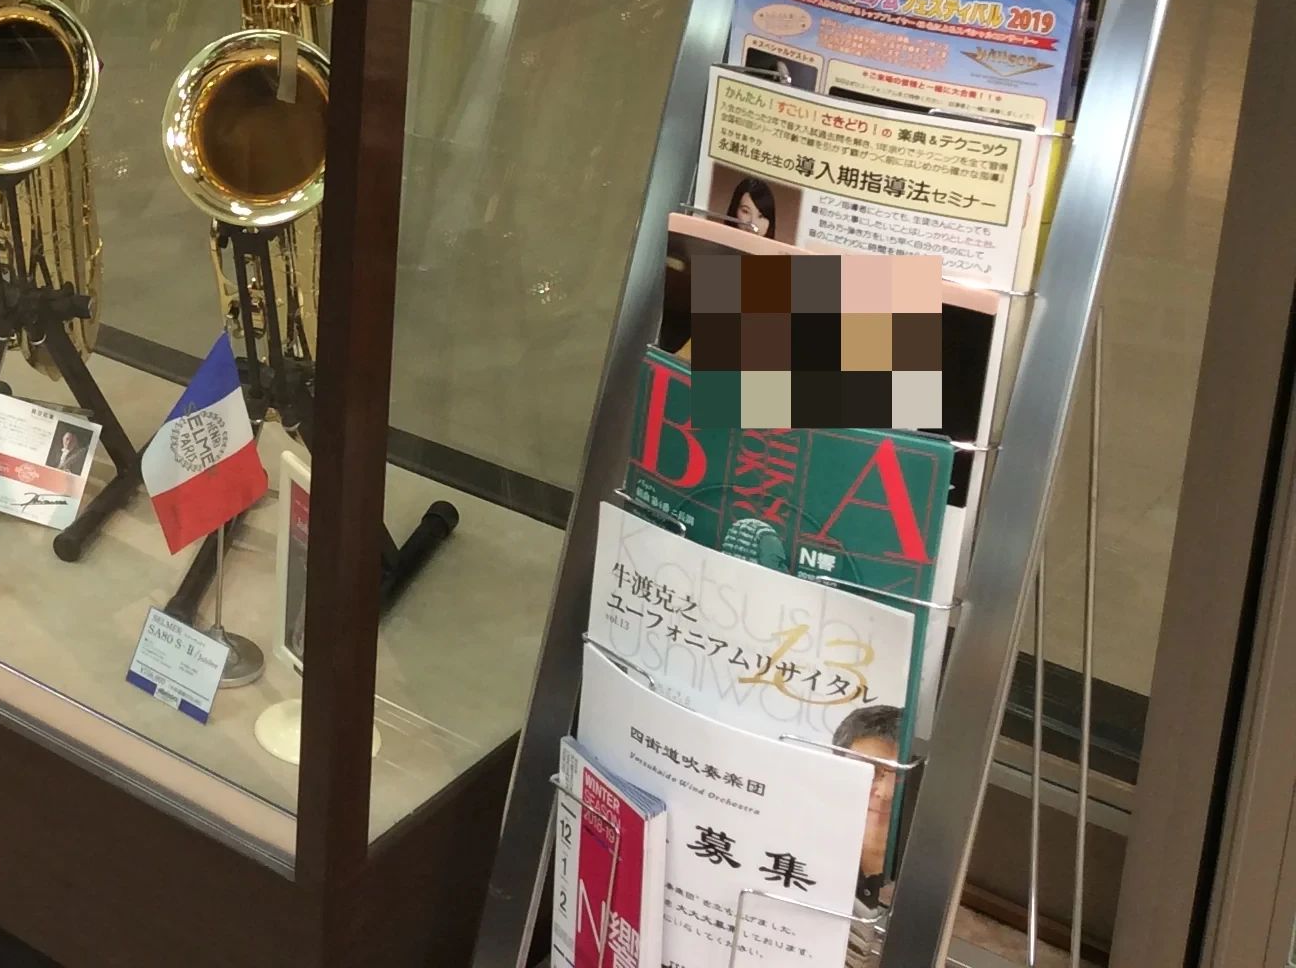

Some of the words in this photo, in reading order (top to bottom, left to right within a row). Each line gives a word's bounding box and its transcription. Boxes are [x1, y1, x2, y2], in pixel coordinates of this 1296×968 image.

[1005, 5, 1057, 35] 2019
[180, 432, 198, 463] PARIS
[611, 561, 699, 624] 牛渡克之
[606, 591, 879, 706] ユーフォニアムリサイタル
[630, 726, 767, 797] 四街道吹奏楽団
[584, 770, 621, 812] WINTER
[678, 778, 706, 796] Wind
[707, 790, 761, 816] Orchestra
[559, 819, 572, 845] 12
